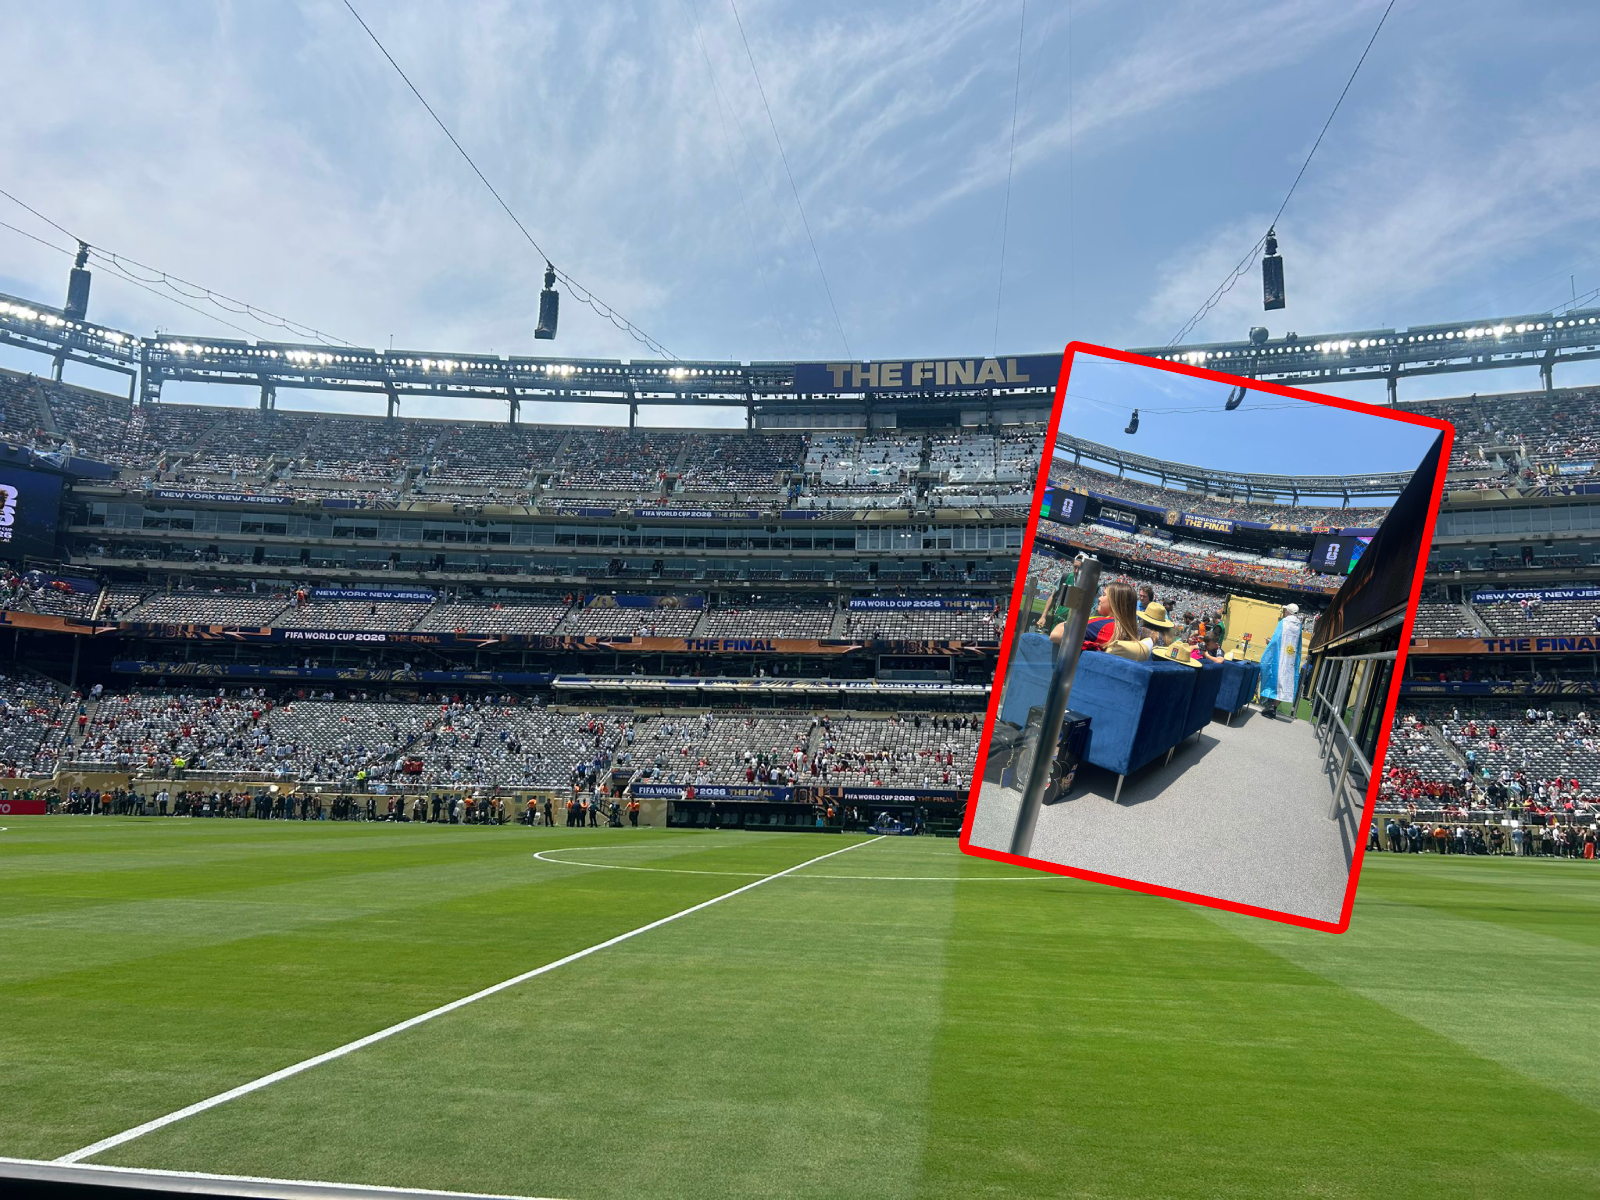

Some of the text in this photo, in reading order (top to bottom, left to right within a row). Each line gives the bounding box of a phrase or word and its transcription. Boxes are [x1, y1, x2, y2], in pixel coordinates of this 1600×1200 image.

[826, 358, 1030, 388] THE FINAL
[187, 492, 216, 500] YORK
[1185, 518, 1231, 532] THE FINAL
[1302, 585, 1325, 593] FINAL
[305, 632, 336, 640] WORLD
[337, 633, 354, 641] CUP
[388, 634, 410, 642] THE
[411, 635, 441, 643] FINAL
[684, 639, 776, 651] THE FINAL
[1483, 638, 1531, 652] THE
[656, 787, 681, 795] WORLD
[700, 788, 726, 796] 2026
[748, 789, 774, 797] FIAL
